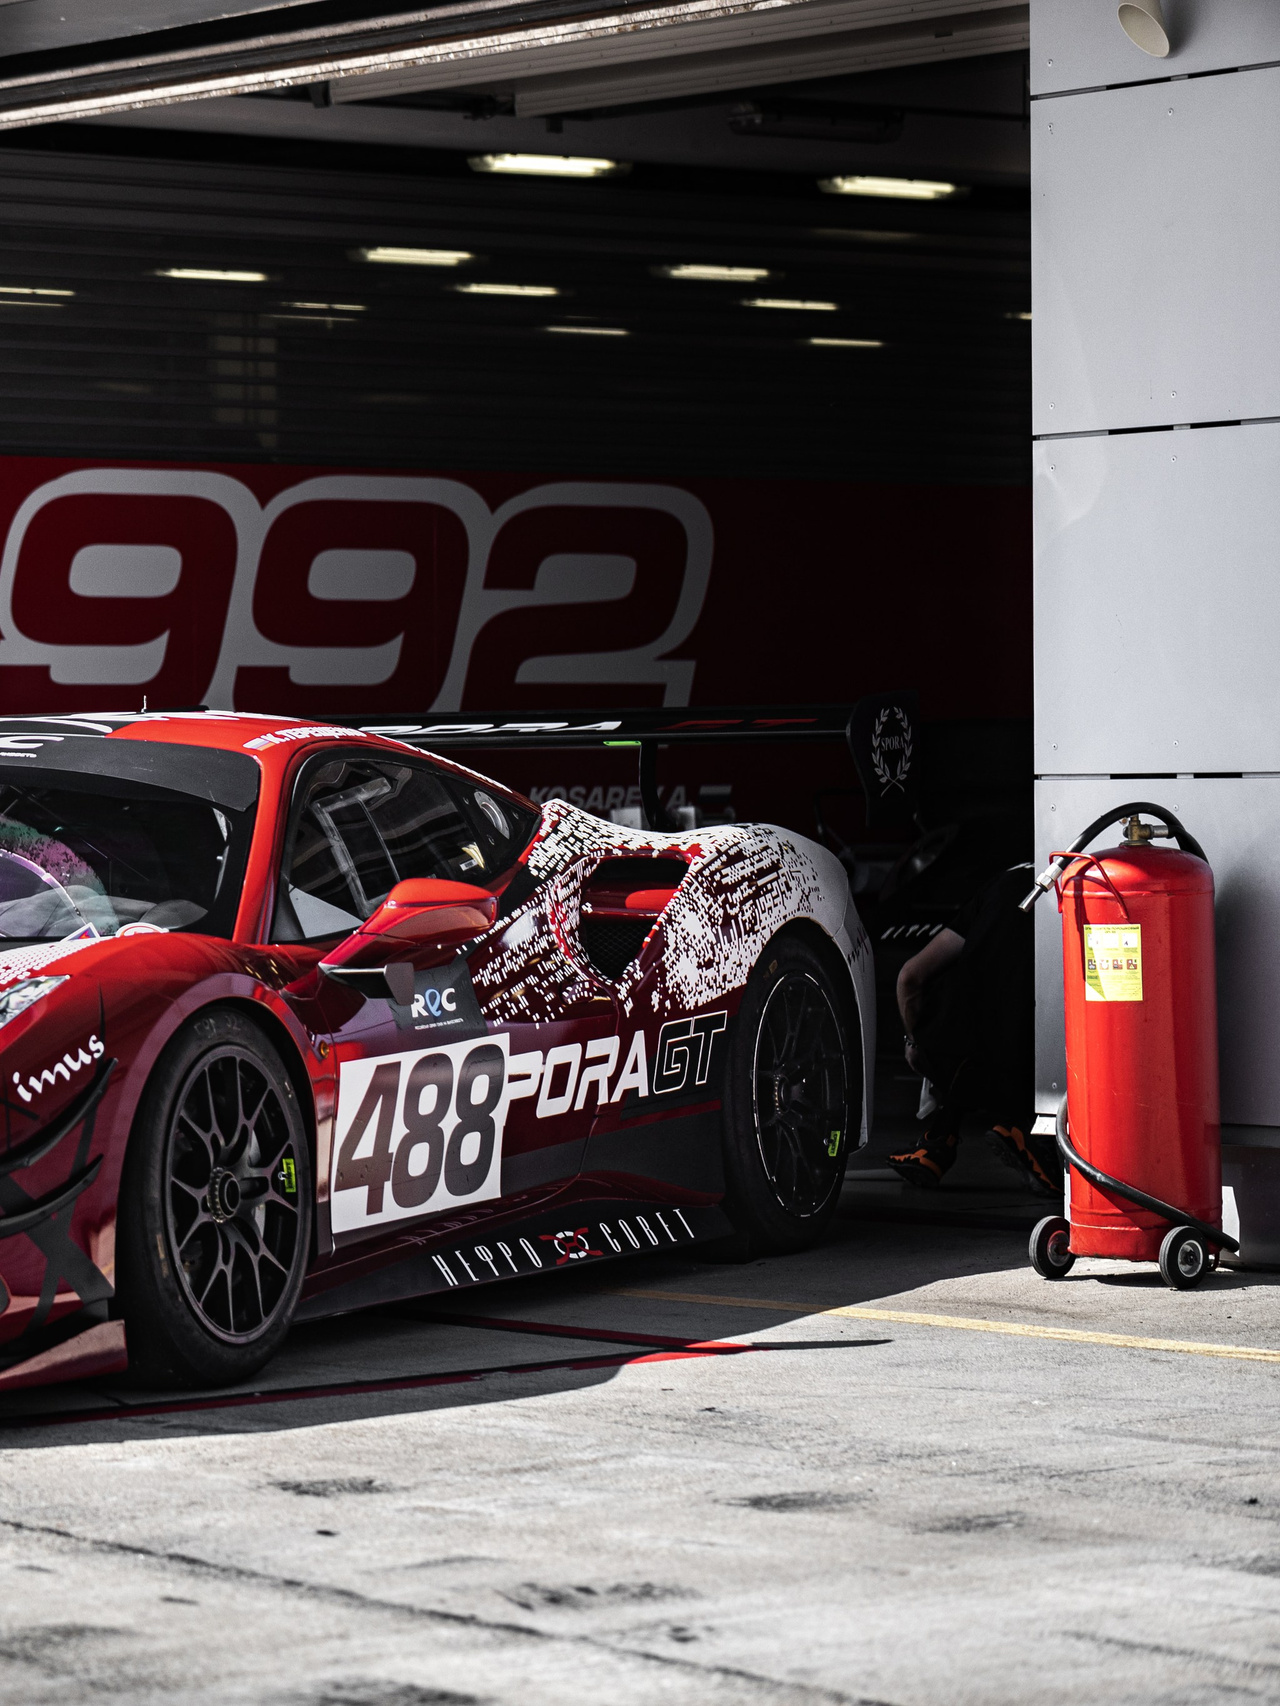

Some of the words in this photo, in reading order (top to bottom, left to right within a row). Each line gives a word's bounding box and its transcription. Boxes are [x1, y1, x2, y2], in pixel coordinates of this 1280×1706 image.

[881, 735, 905, 752] SPORA
[529, 785, 664, 812] KOSARE
[333, 1043, 506, 1216] 488
[599, 1208, 695, 1253] СОВЕТ
